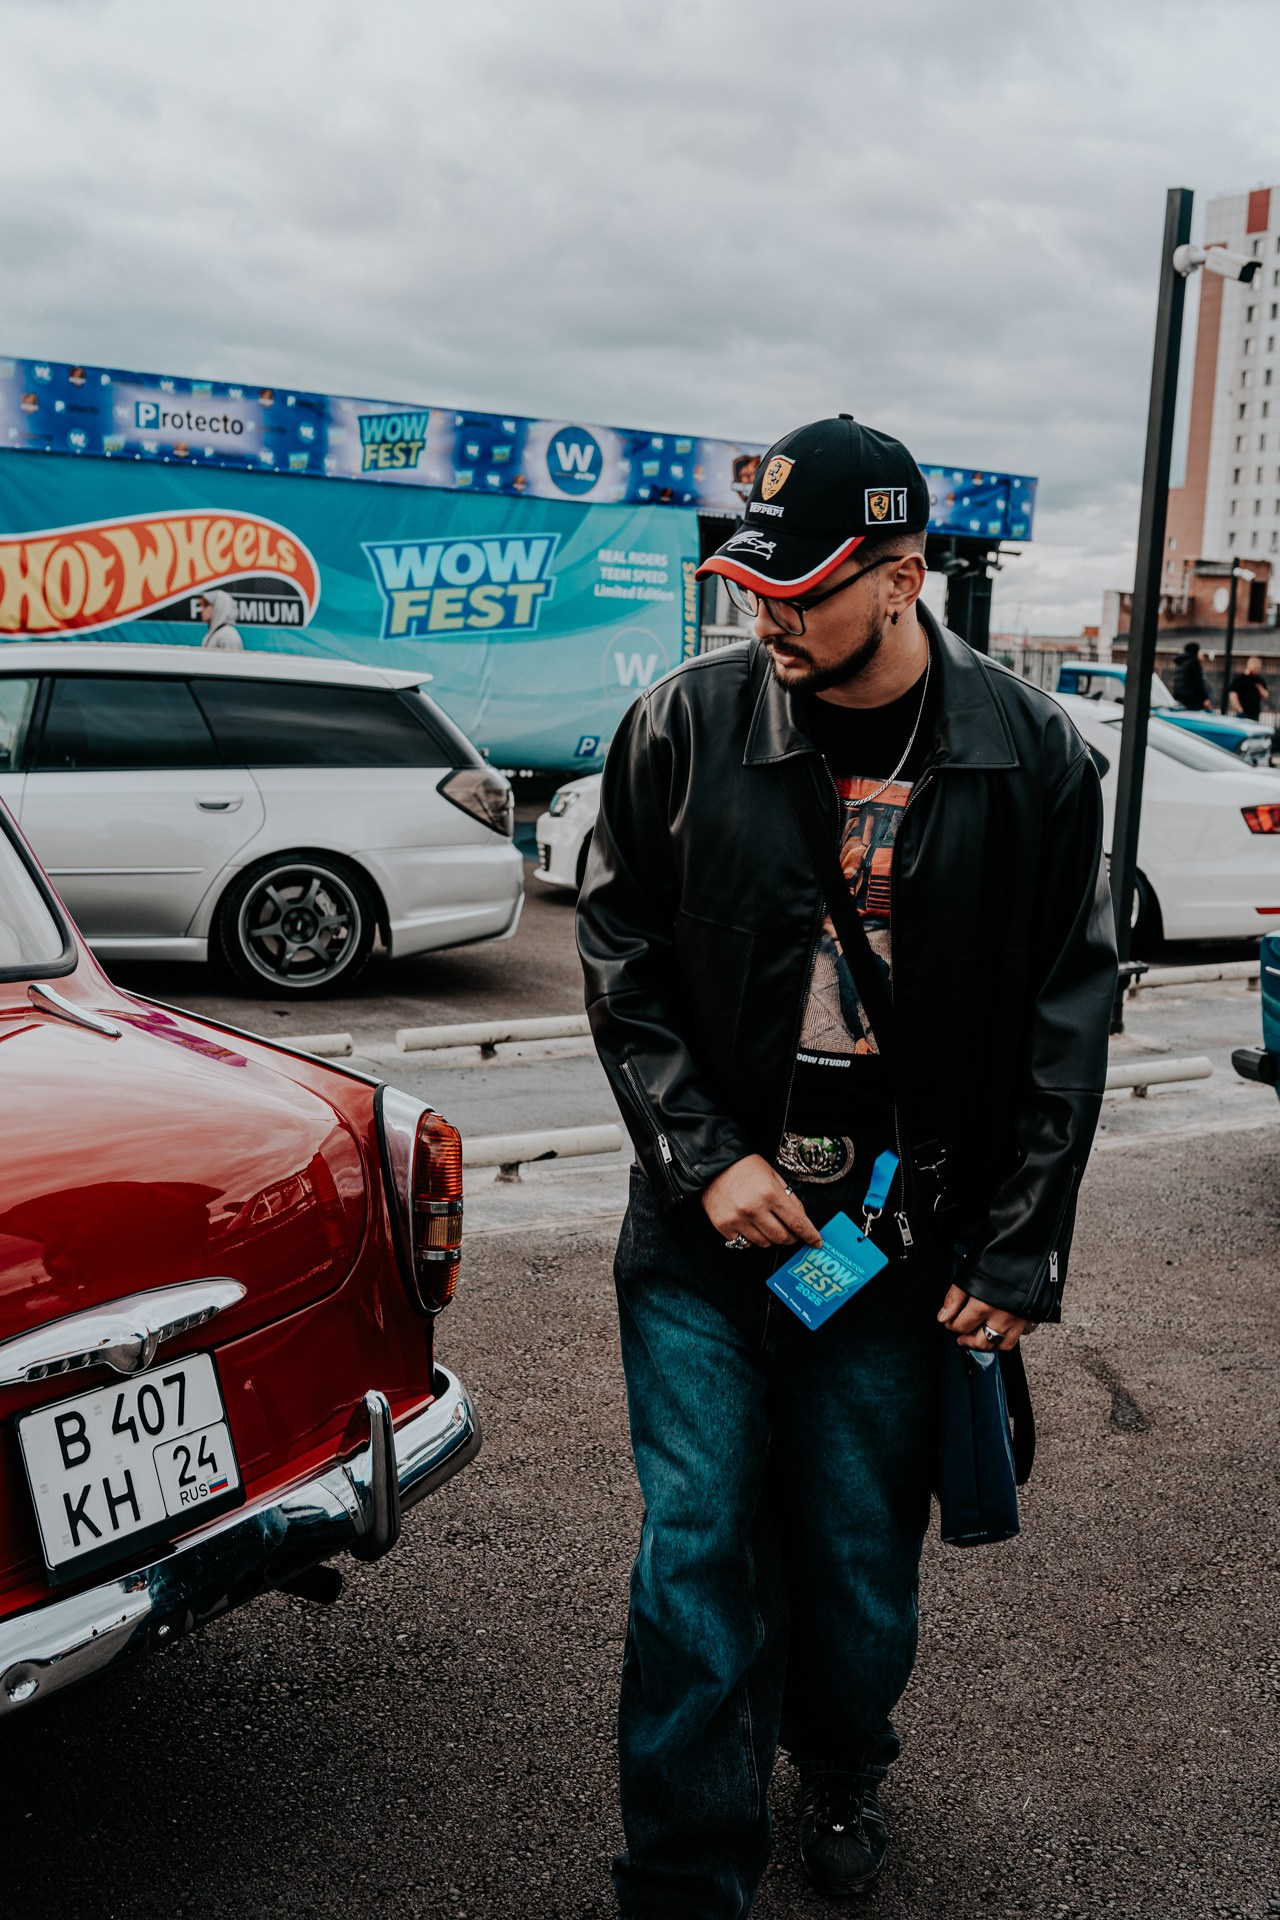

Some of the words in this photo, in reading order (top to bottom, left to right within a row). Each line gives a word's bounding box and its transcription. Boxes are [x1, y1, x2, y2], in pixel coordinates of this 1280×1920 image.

[137, 402, 244, 436] Protecto
[362, 414, 426, 443] WOW
[363, 442, 423, 470] FEST
[555, 441, 594, 472] W
[749, 502, 784, 518] Ferrari
[374, 539, 549, 590] WOW
[598, 549, 627, 564] REAL
[628, 551, 669, 567] RIDERS
[632, 568, 669, 584] SPEED
[594, 583, 636, 599] Limited
[636, 585, 675, 601] Edition
[682, 560, 697, 623] SERIES
[190, 597, 299, 624] PMIUM
[389, 583, 546, 635] FEST
[613, 651, 658, 687] W
[817, 1057, 851, 1068] STUDIO
[792, 1260, 843, 1298] FEST
[806, 1247, 859, 1287] WOW
[795, 1282, 823, 1307] 2025
[111, 1371, 186, 1444] 407
[172, 1435, 218, 1488] 24
[179, 1483, 208, 1506] RUS
